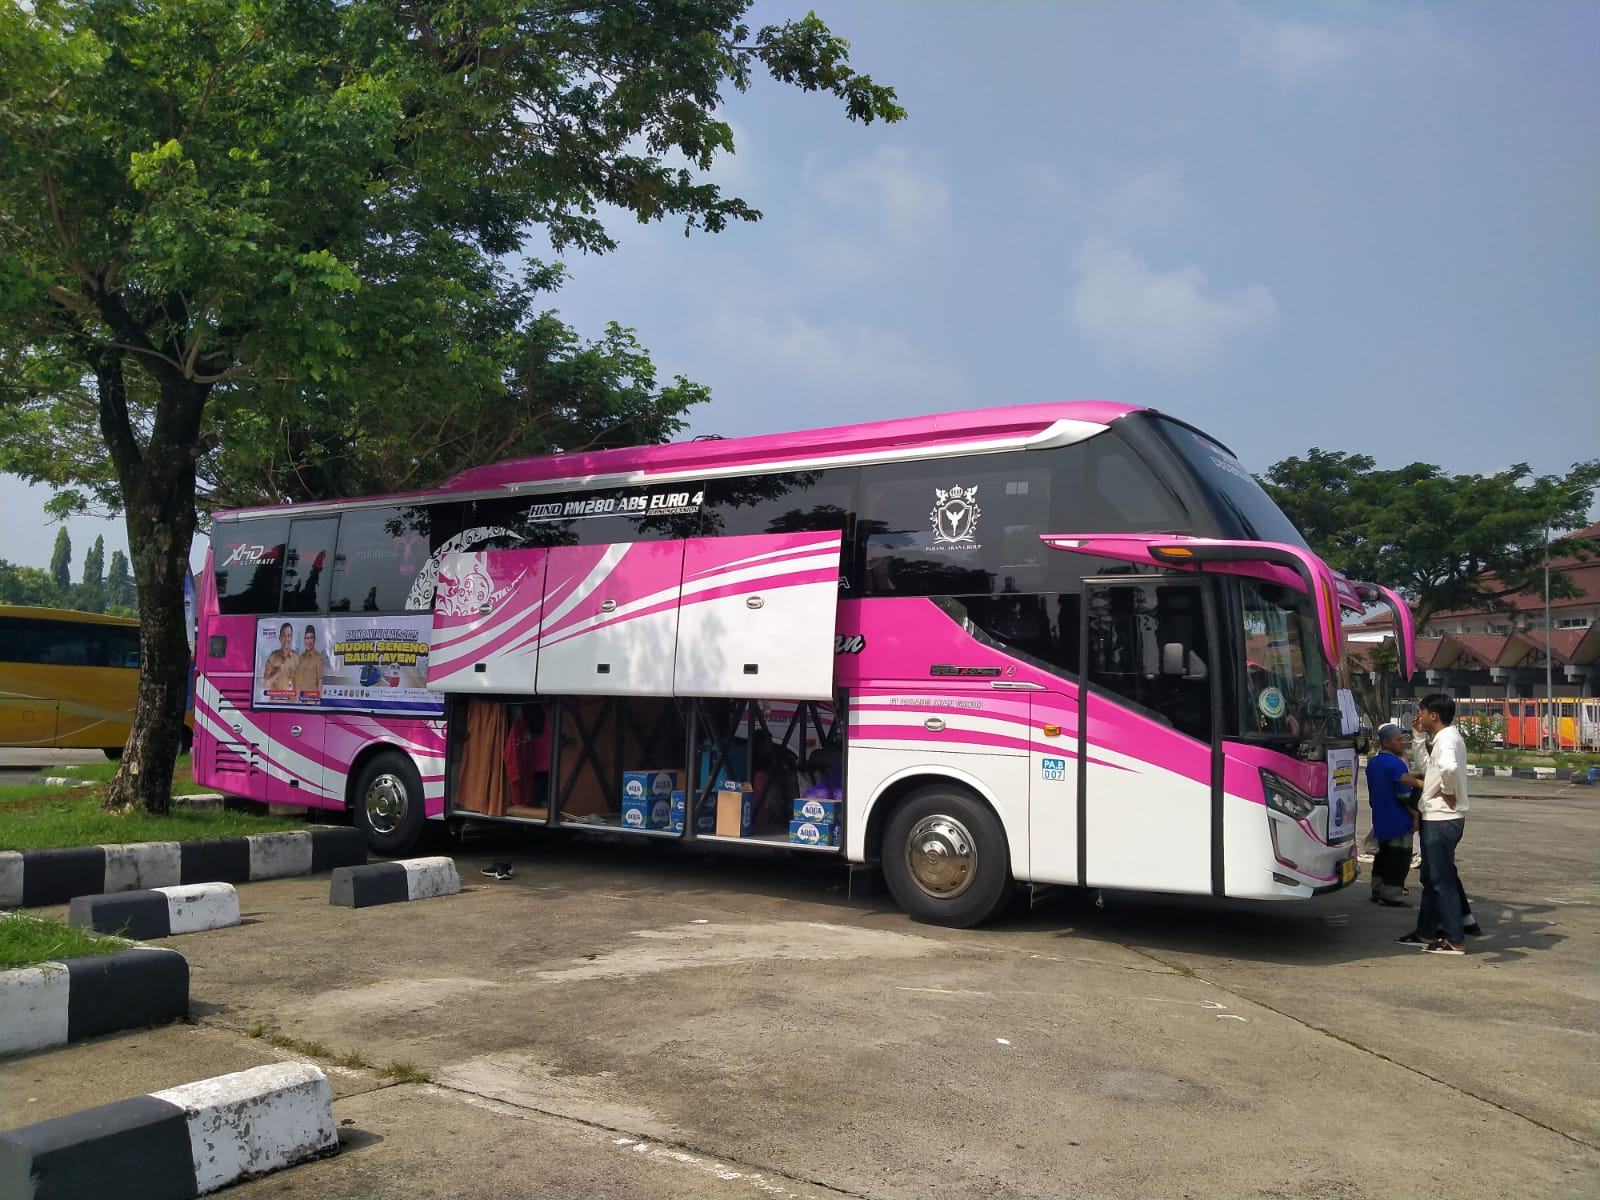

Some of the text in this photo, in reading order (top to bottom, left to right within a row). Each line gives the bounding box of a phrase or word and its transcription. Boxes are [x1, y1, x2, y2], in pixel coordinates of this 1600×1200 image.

[528, 491, 704, 517] HINO RM280 ABS EURO 4
[403, 630, 419, 641] 2025
[334, 642, 429, 655] MUDIK SENENG
[344, 653, 416, 664] BALIK AYEM
[1044, 770, 1062, 779] 007
[804, 806, 822, 815] AQUA
[800, 828, 817, 838] AQUA
